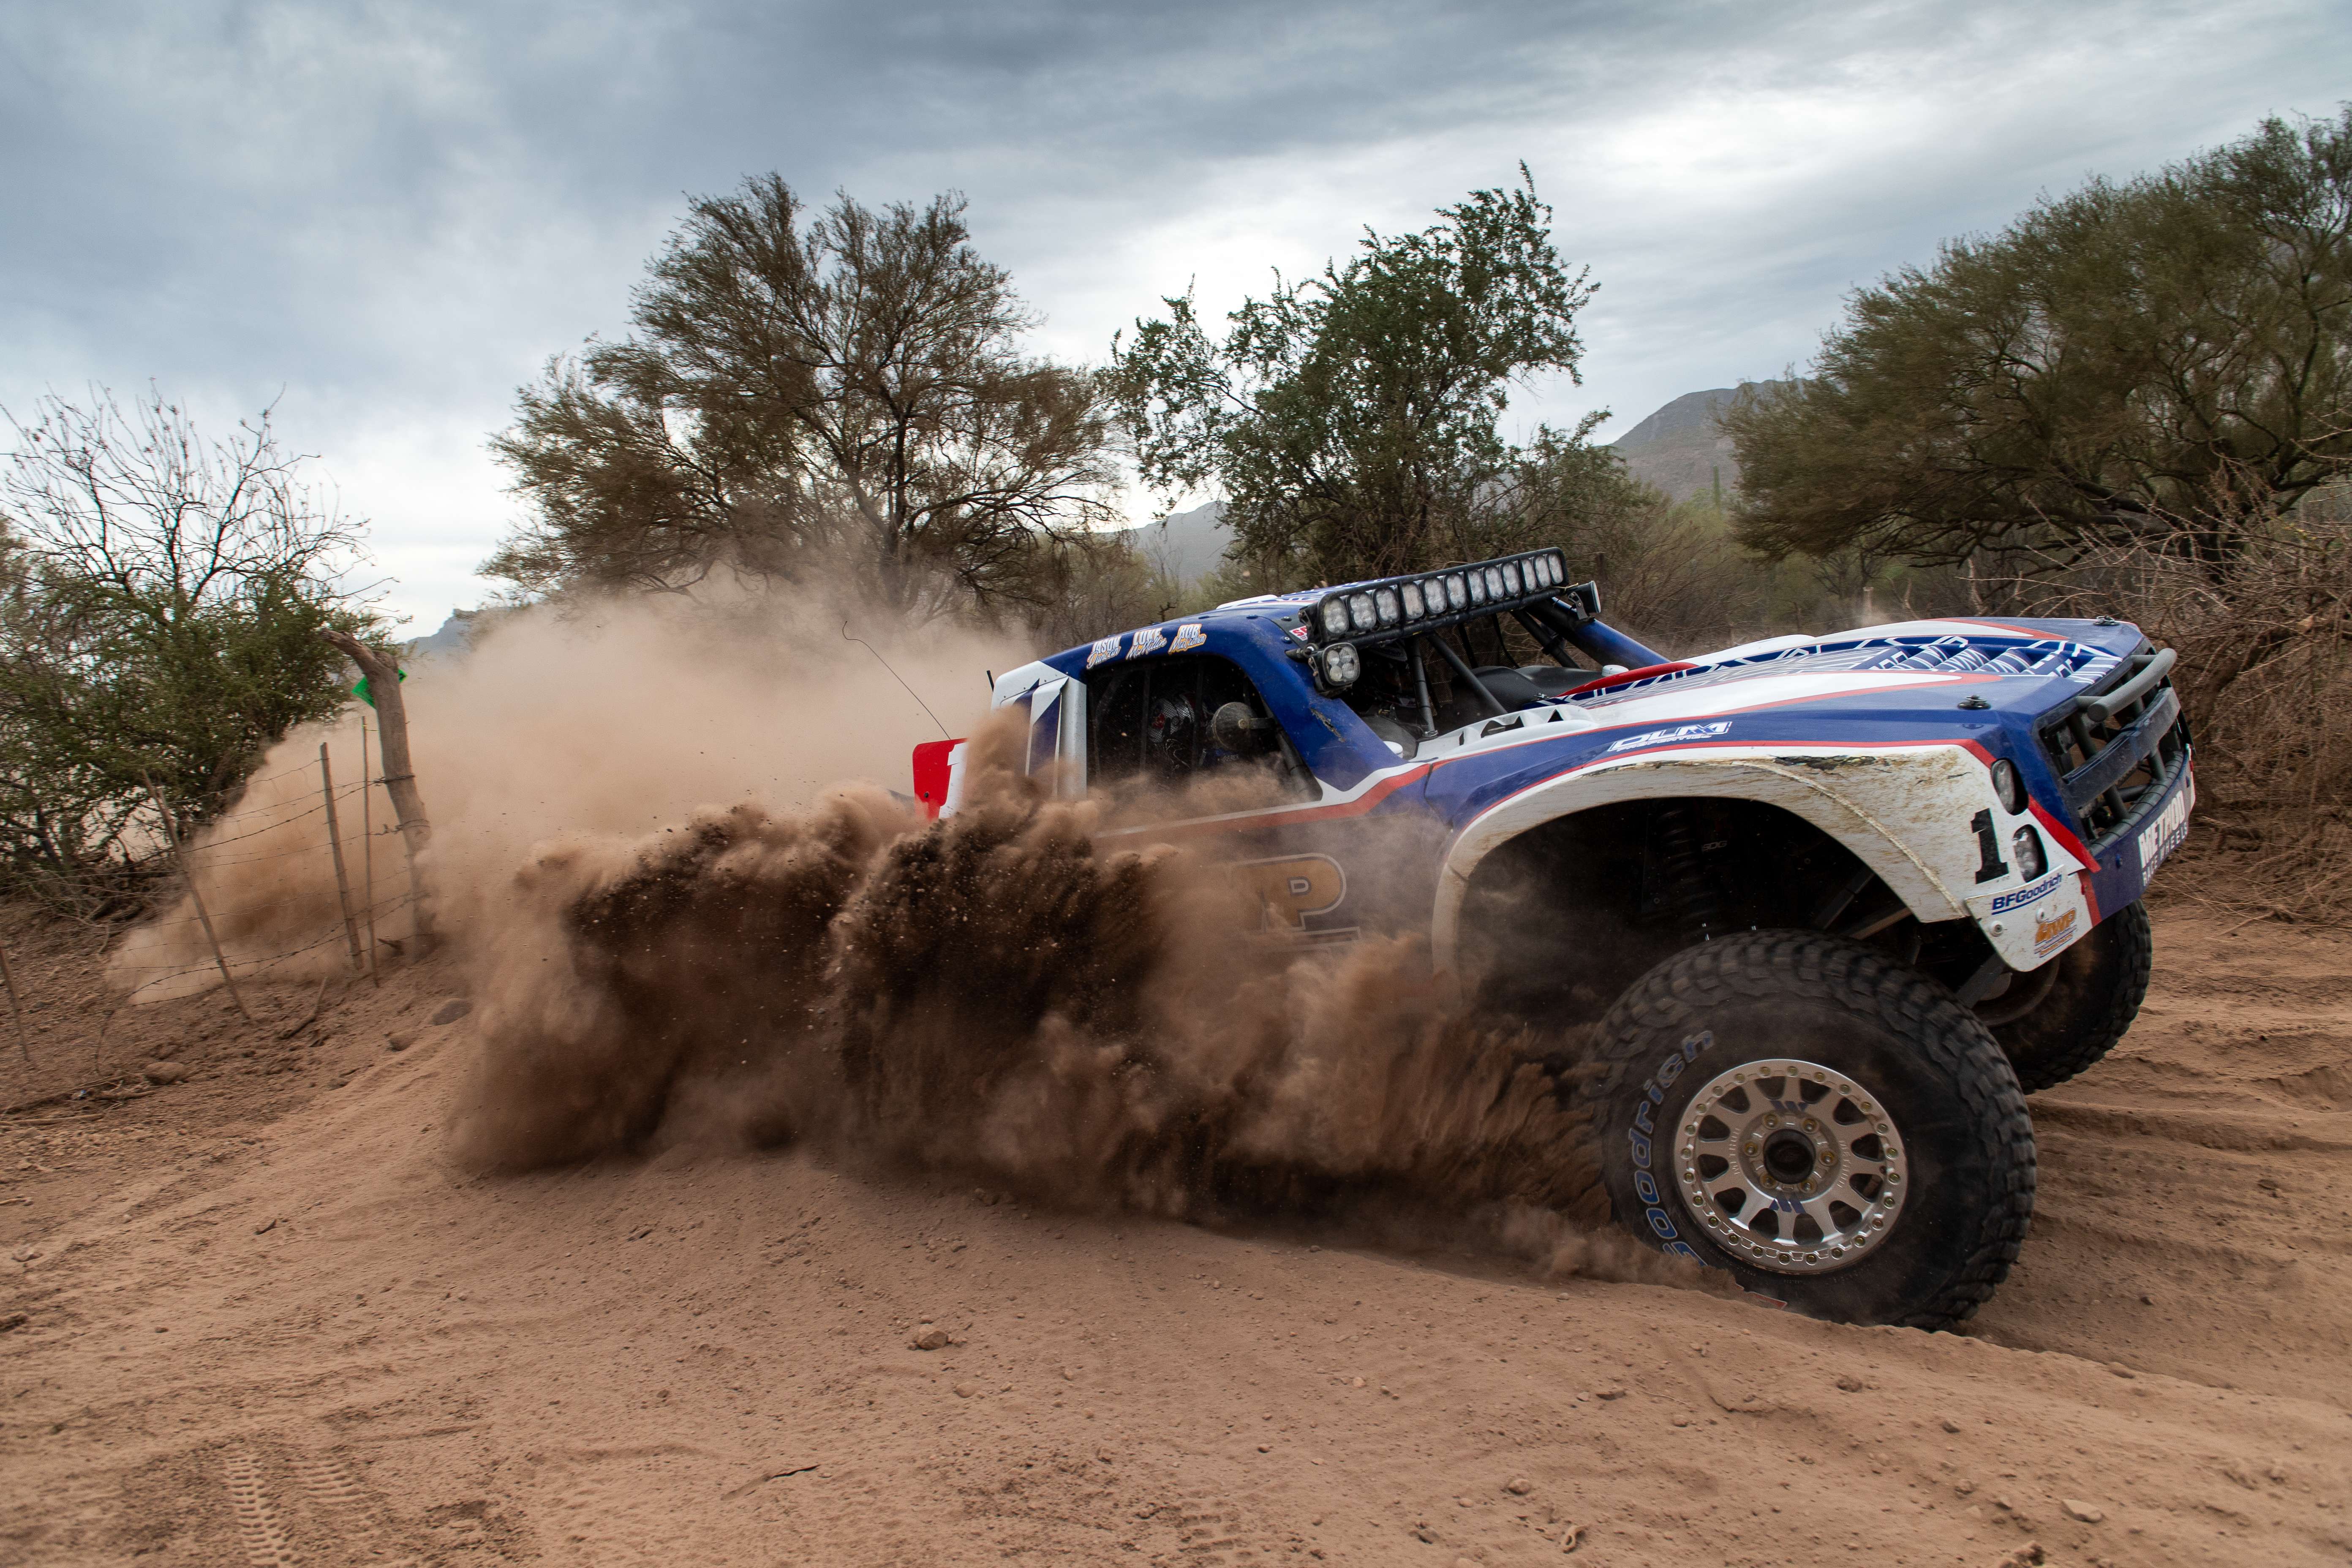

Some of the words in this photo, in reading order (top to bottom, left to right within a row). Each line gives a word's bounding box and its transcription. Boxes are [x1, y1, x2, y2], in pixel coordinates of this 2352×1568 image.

[1092, 636, 1122, 653] JASON
[1132, 628, 1162, 645] LUKE
[1178, 624, 1202, 639] ROB
[1087, 647, 1121, 669] Duncan
[1607, 721, 1733, 752] DLM
[2138, 790, 2186, 869] METHOD
[2142, 855, 2158, 886] RACE
[2160, 822, 2189, 860] WHEELS
[1992, 873, 2063, 910] BFGoodrich
